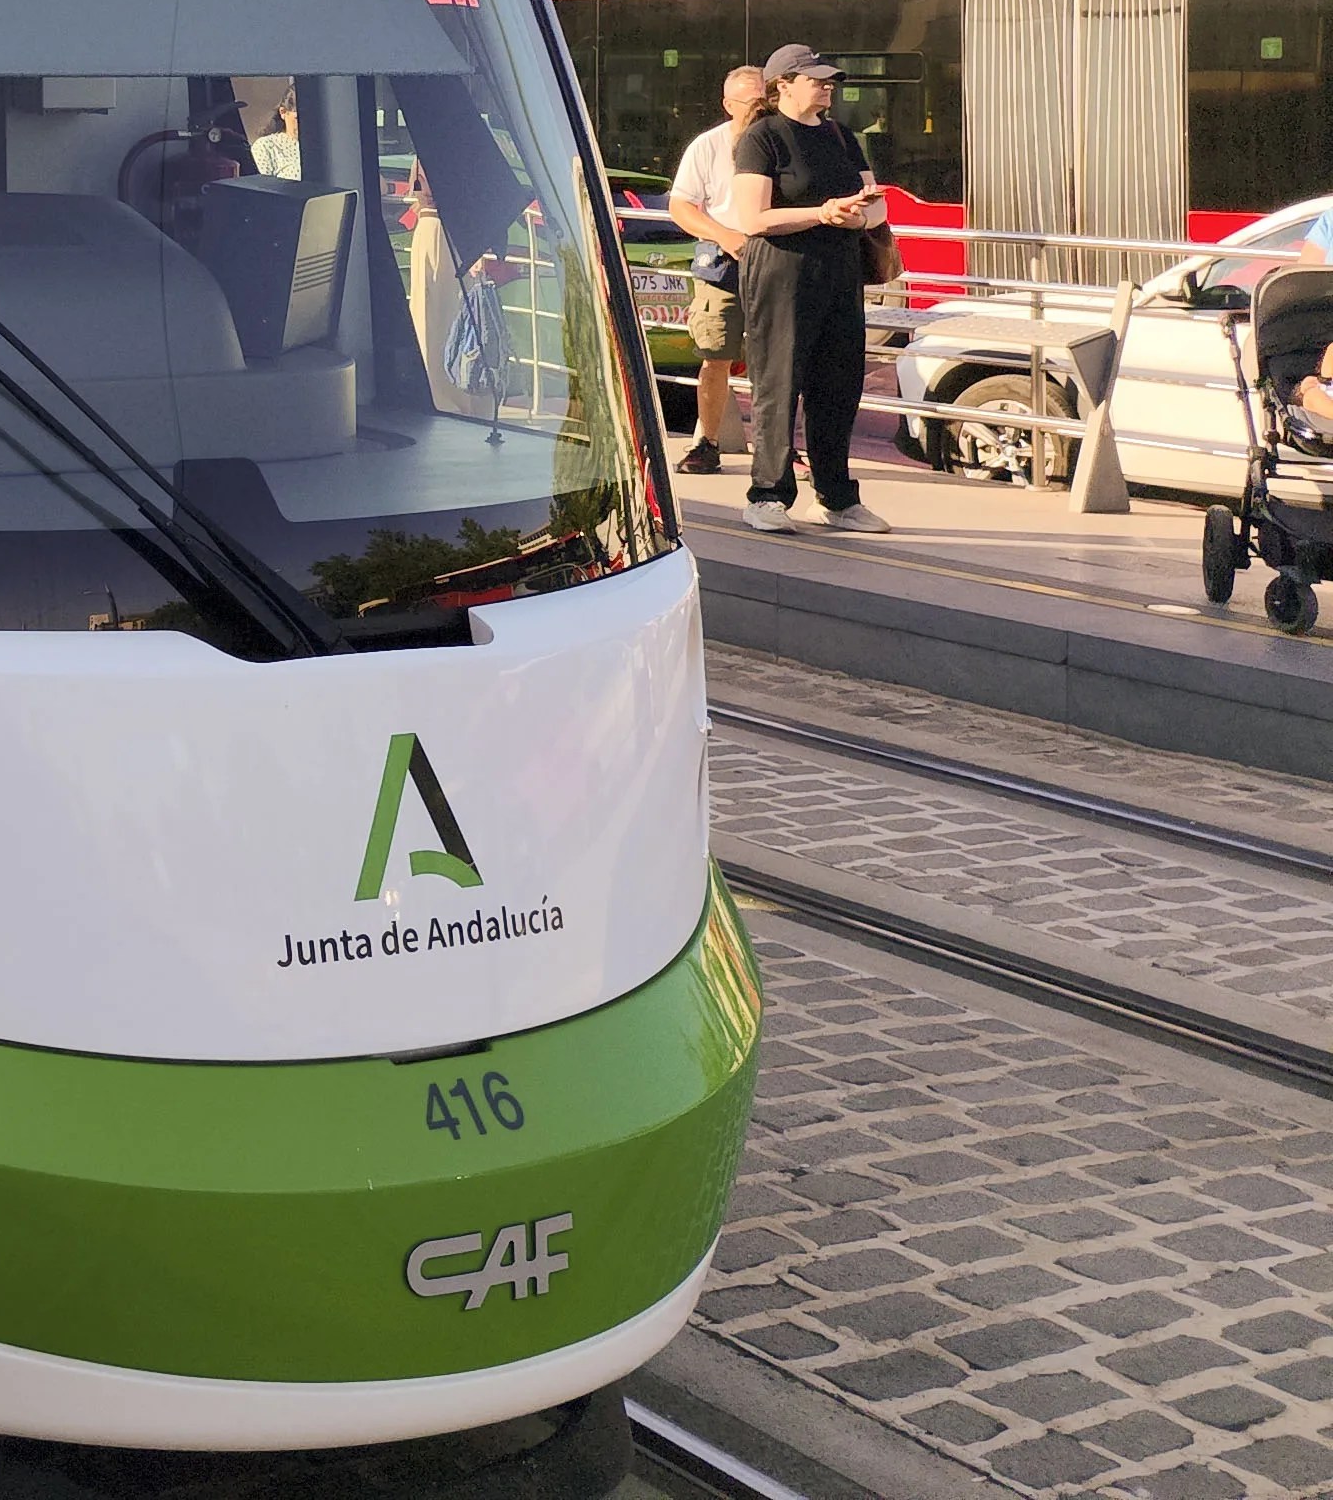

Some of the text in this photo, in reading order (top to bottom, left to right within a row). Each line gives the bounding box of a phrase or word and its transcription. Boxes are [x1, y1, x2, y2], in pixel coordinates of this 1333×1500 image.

[277, 894, 564, 968] Junta de Andalucía
[425, 1071, 525, 1141] 416
[405, 1211, 573, 1311] CAF
